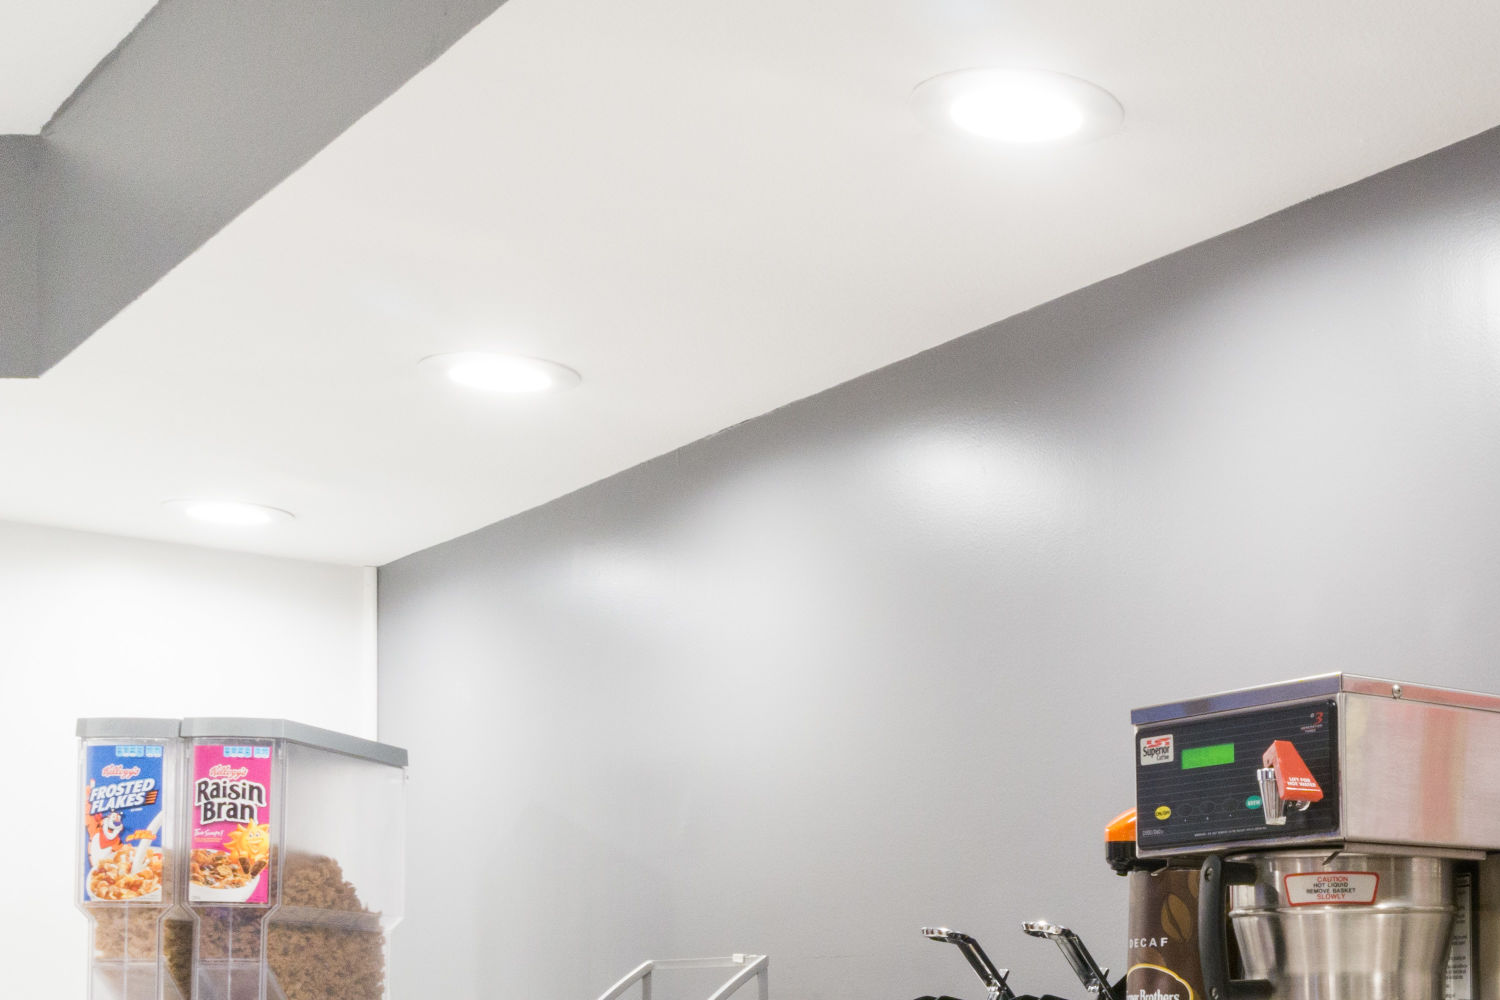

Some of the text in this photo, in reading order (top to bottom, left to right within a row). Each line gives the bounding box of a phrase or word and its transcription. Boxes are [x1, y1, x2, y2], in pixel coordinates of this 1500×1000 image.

[90, 778, 156, 802] FROSTED
[197, 780, 264, 806] Raisin
[90, 791, 146, 815] FLAKES
[203, 801, 257, 822] Bran
